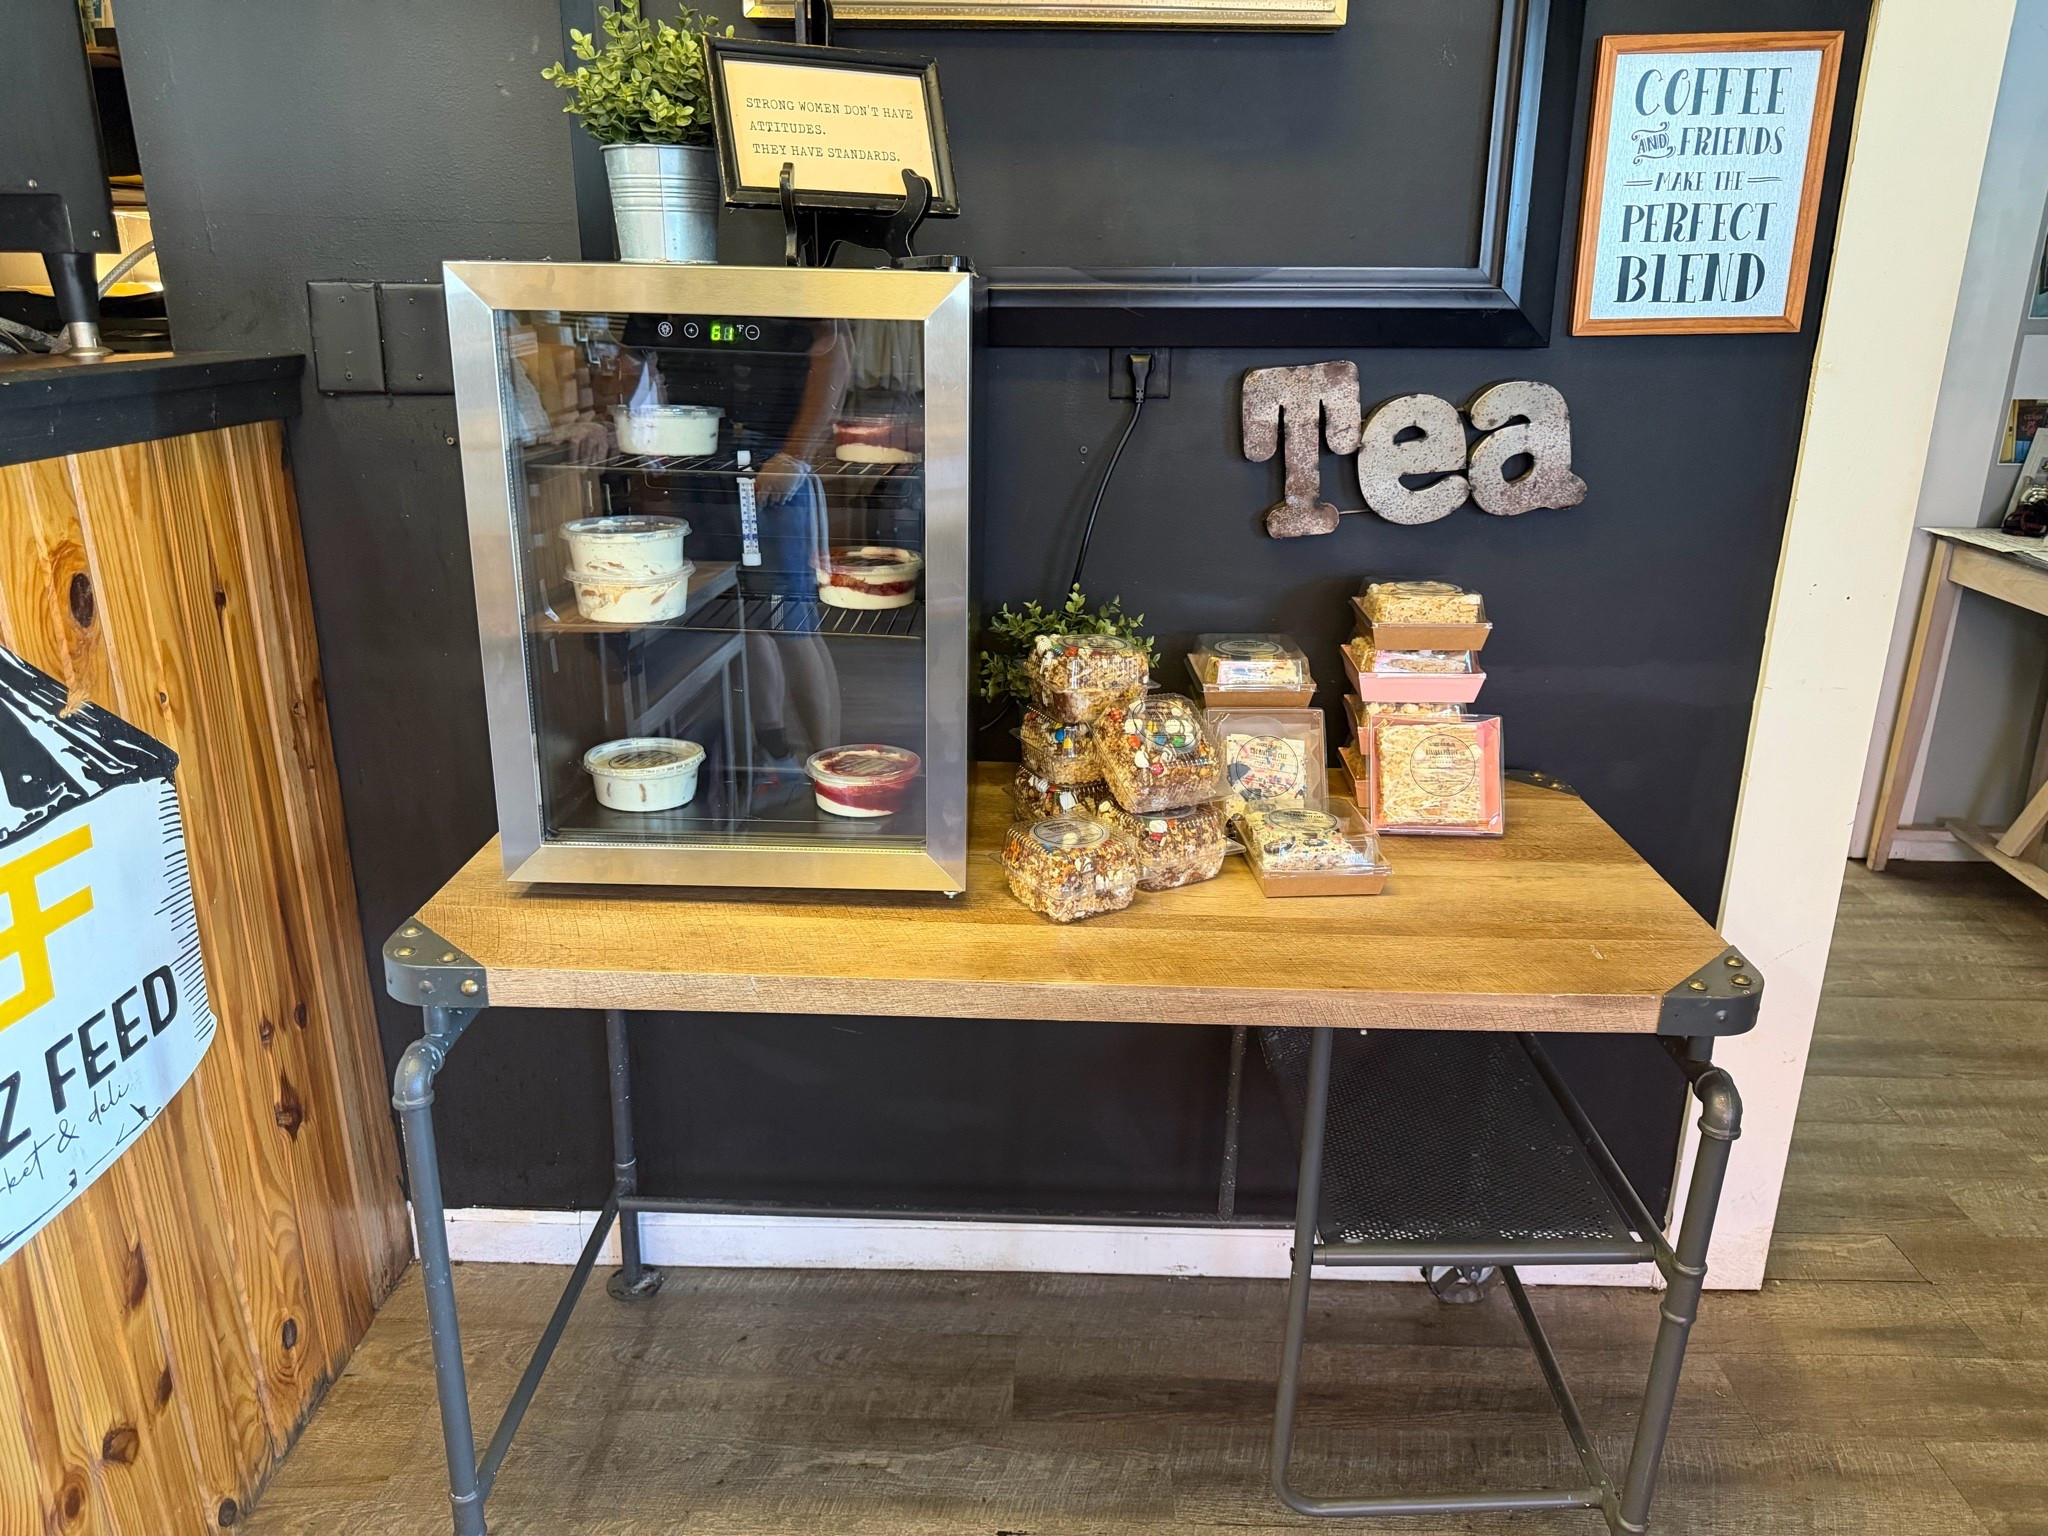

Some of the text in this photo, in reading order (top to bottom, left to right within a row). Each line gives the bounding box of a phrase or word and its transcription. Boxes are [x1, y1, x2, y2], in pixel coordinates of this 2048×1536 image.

[746, 97, 914, 120] STRONG WOMEN DON'T HAVE
[1635, 67, 1792, 116] COFFEE
[749, 120, 826, 136] ATTITUDES.
[1677, 125, 1786, 156] FRIENDS
[752, 143, 901, 162] THEY HAVE STANDARDS.
[1653, 170, 1746, 192] MAKE THE
[1618, 202, 1778, 243] PERFECT
[1613, 252, 1766, 303] BLEND
[1242, 360, 1588, 539] Tea
[45, 964, 178, 1115] FEED
[0, 1080, 130, 1195] ket & deli
